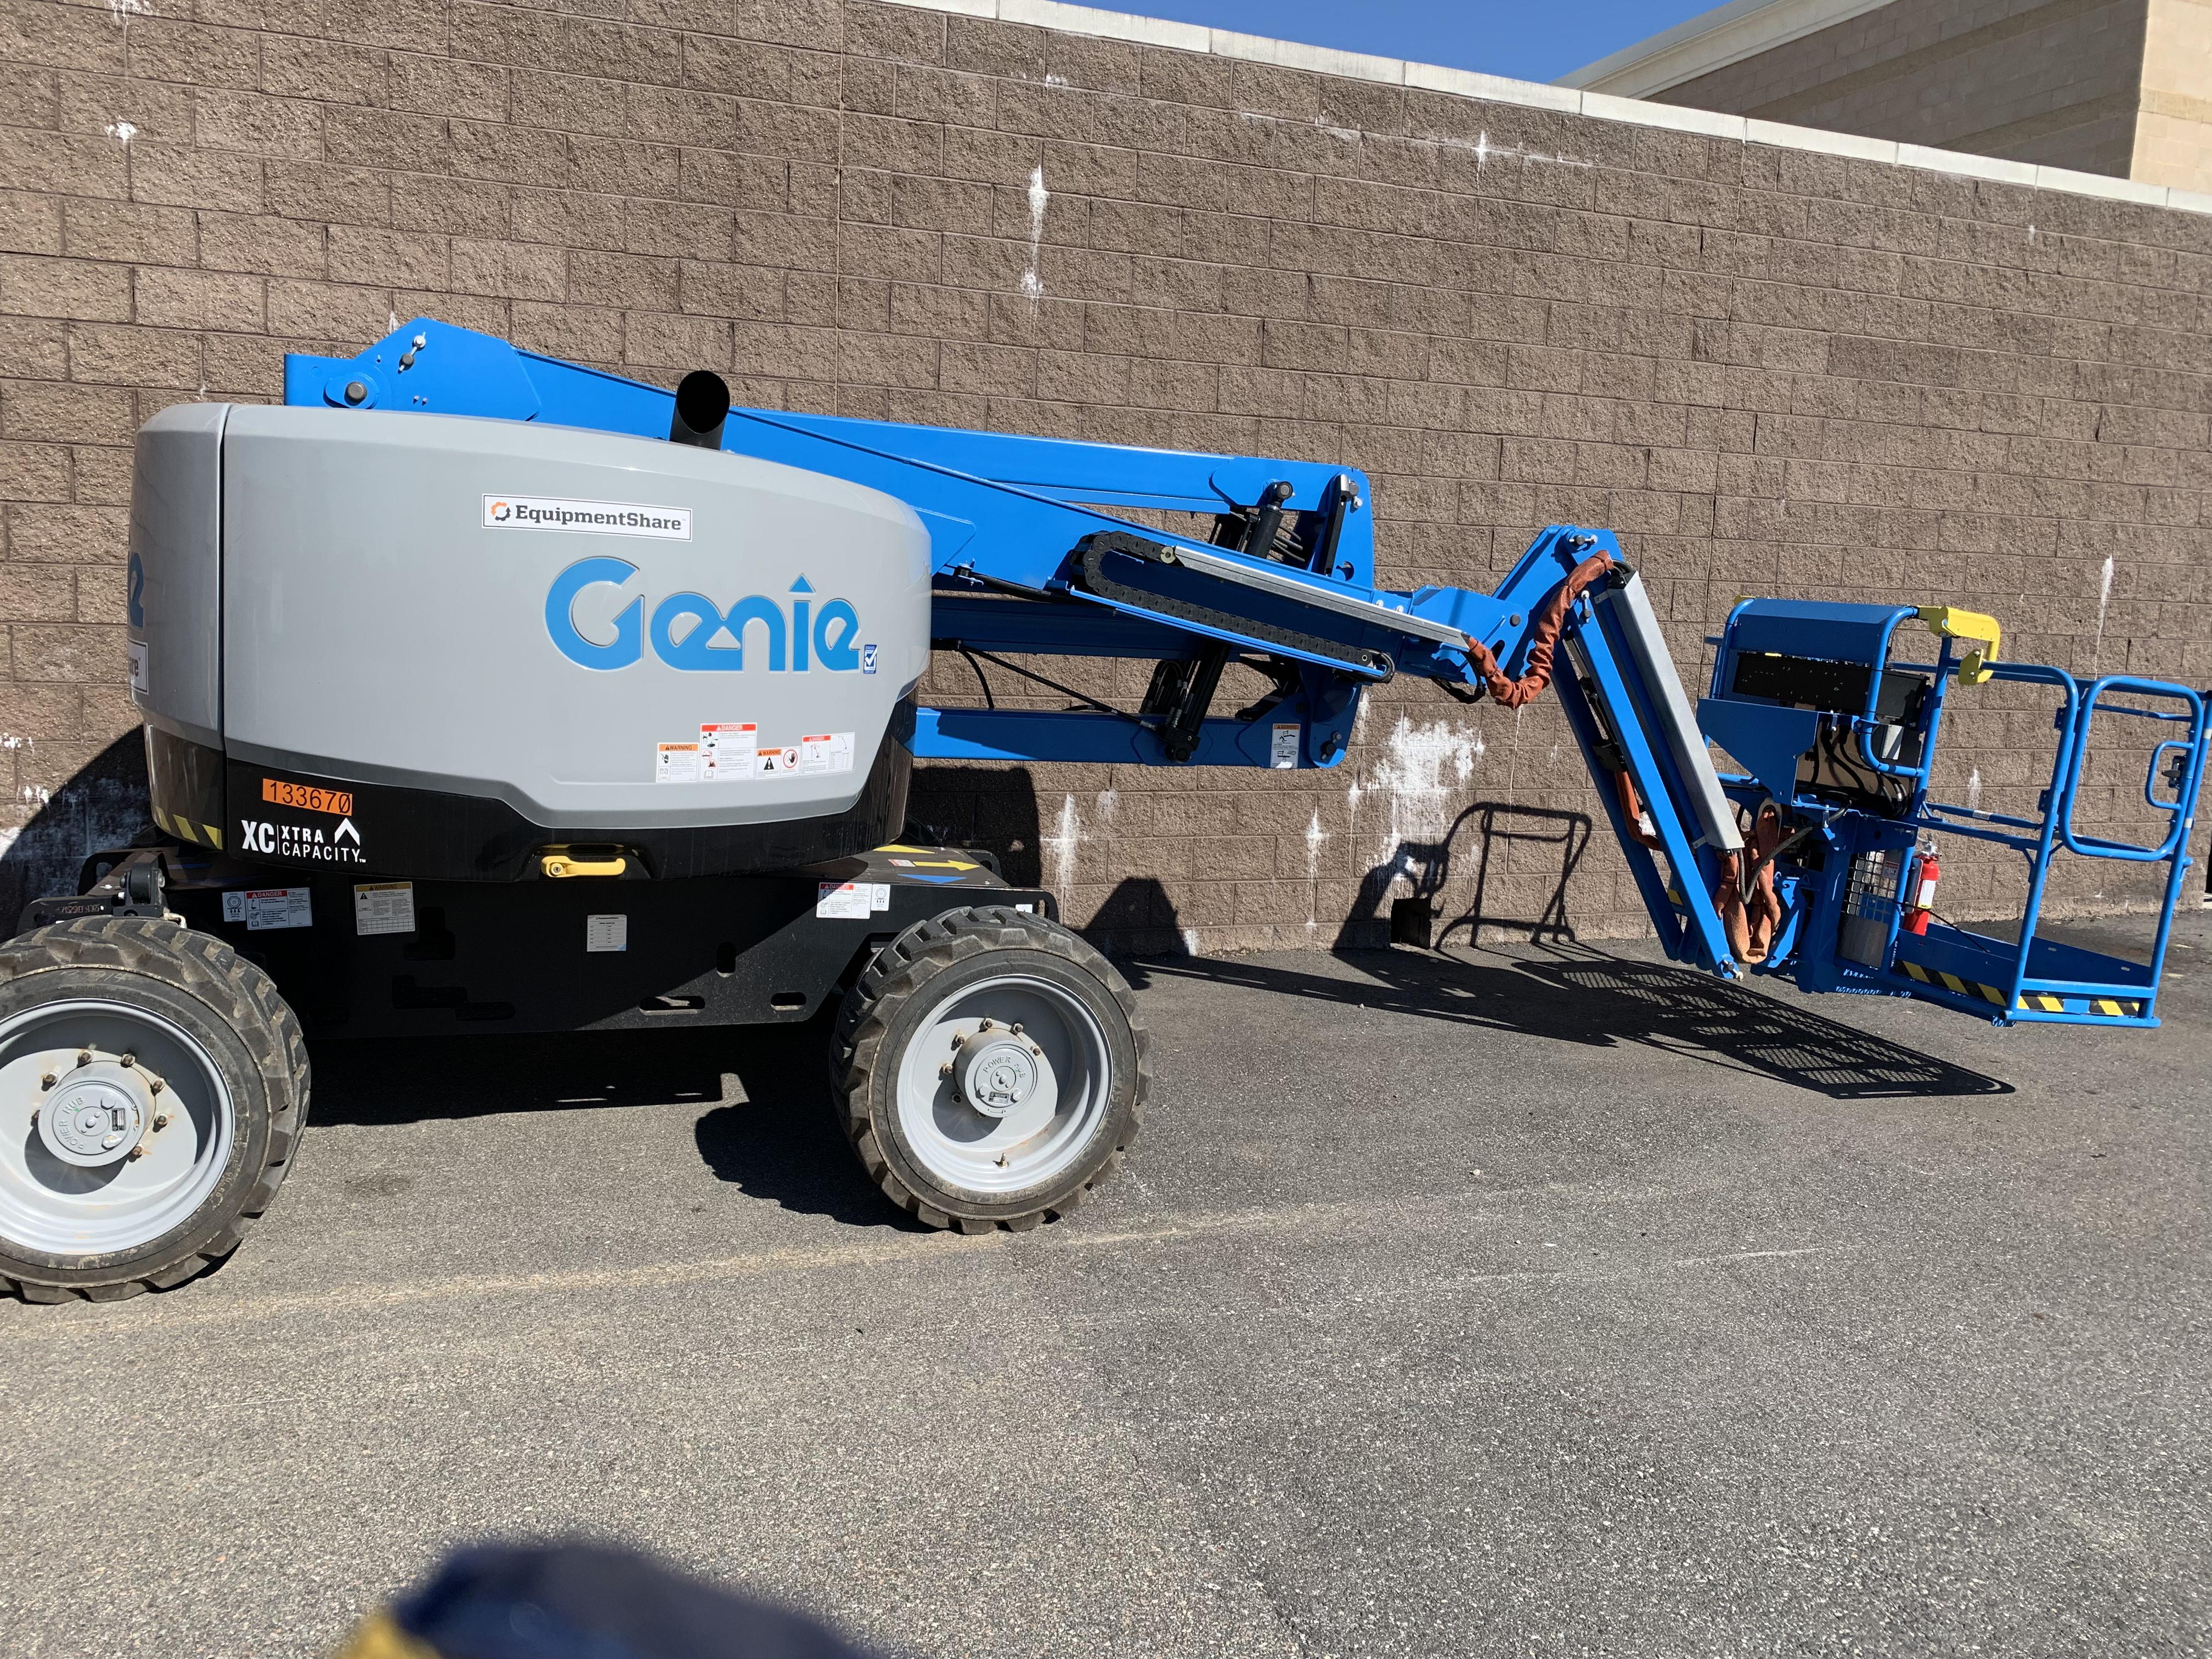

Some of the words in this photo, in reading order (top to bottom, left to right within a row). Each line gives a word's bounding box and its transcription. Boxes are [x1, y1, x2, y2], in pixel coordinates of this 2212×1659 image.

[515, 505, 682, 531] EquipmentShare
[544, 555, 861, 673] Genie
[270, 781, 351, 814] 133670
[241, 820, 275, 854] XC
[281, 825, 324, 844] XTRA
[983, 1056, 1011, 1073] POWER
[62, 1097, 84, 1114] HUB
[58, 1119, 84, 1149] POWER
